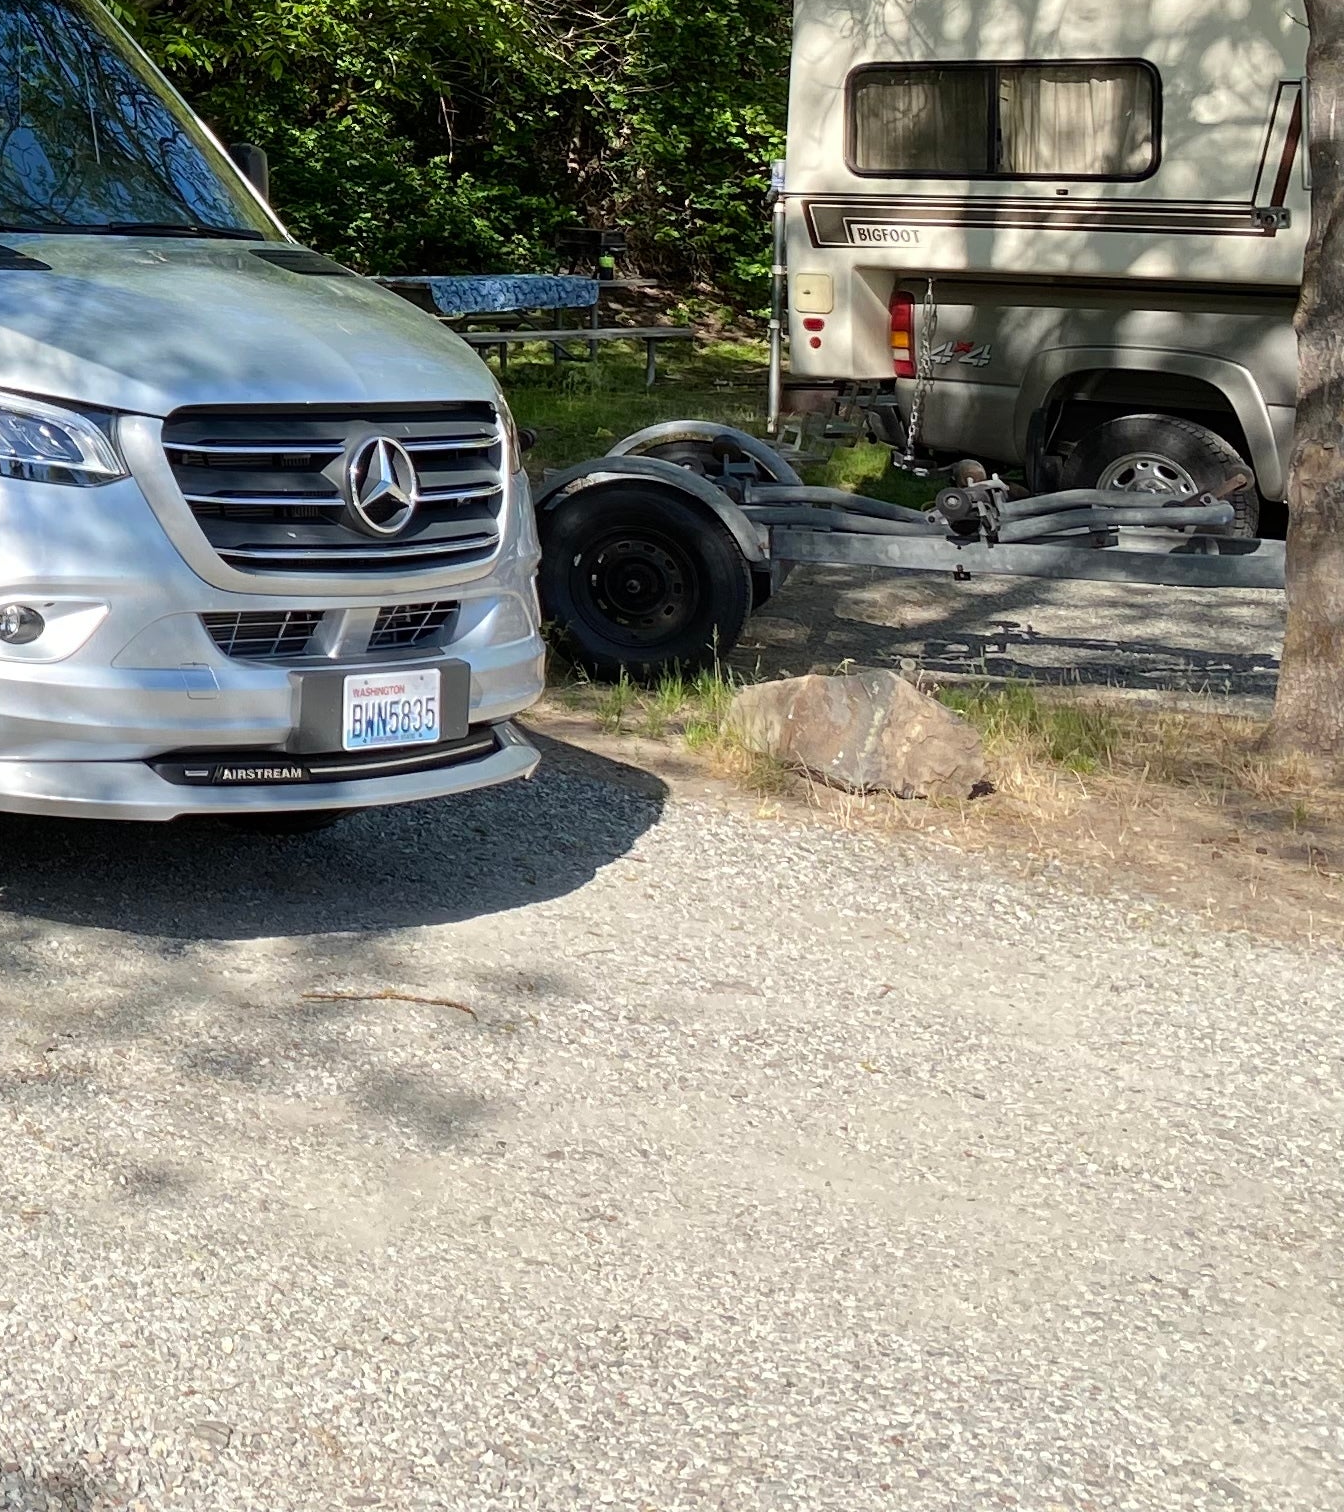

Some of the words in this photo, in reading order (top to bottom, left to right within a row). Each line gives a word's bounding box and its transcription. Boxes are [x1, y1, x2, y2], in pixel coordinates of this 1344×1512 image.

[856, 227, 920, 244] BIGFOOT
[352, 684, 406, 698] WASHINGTON
[352, 696, 436, 739] BWN5835
[222, 767, 302, 780] AIRSTREAM
